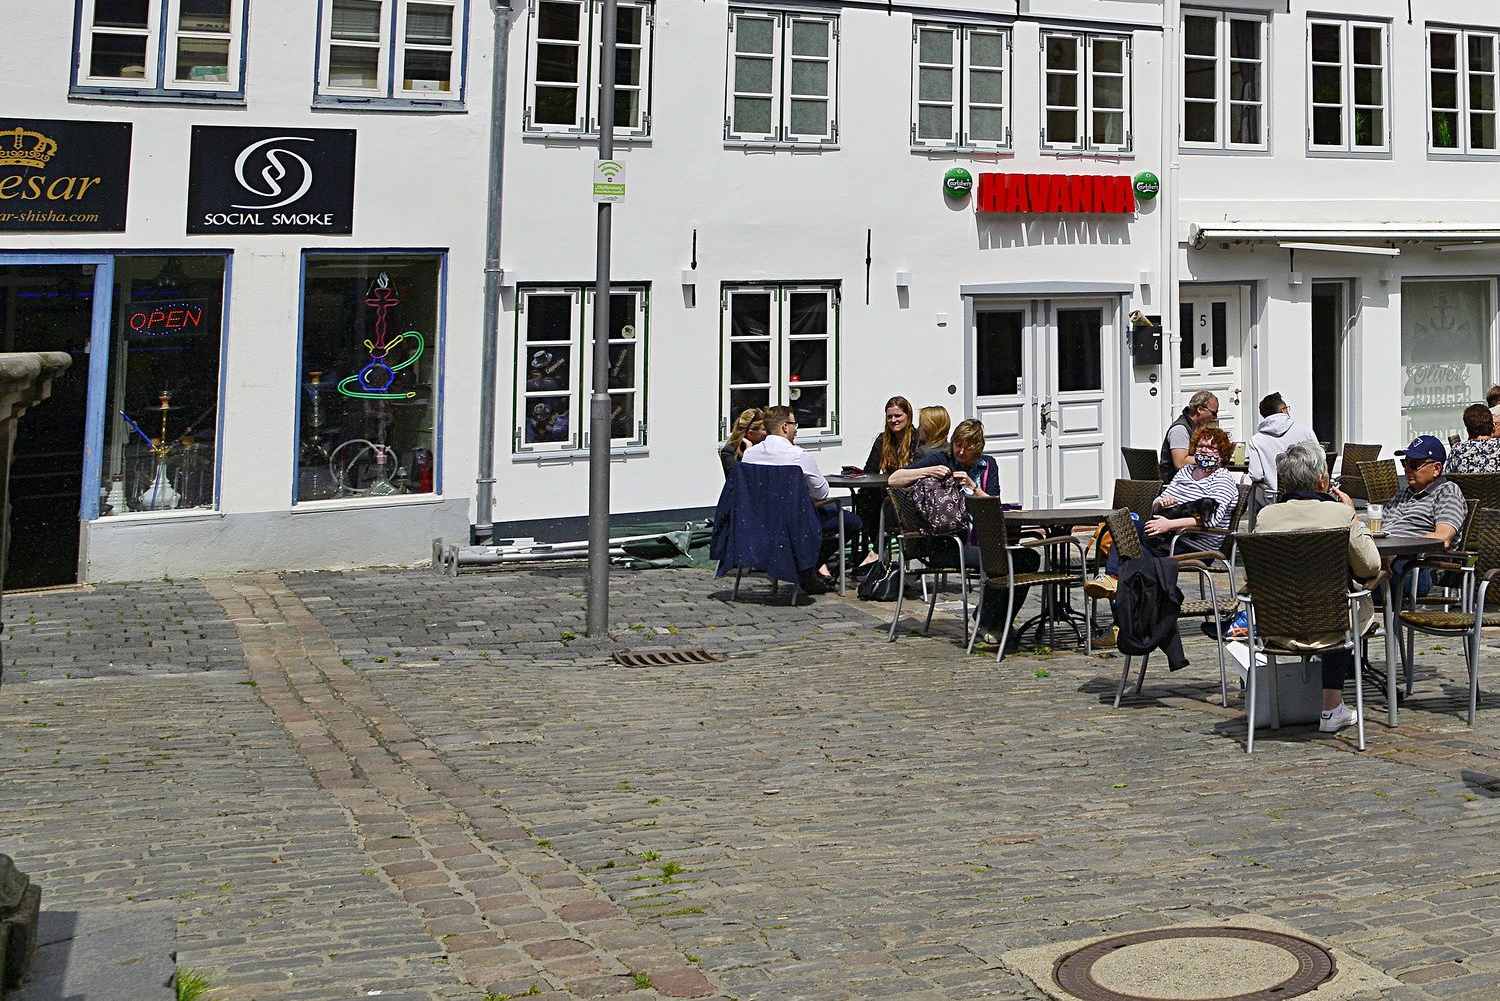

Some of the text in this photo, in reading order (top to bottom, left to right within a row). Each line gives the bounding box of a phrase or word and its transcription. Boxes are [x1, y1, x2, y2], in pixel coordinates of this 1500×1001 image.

[977, 172, 1136, 214] HAVANNA
[204, 213, 334, 226] SOCIAL SMOKE
[130, 310, 203, 330] OPEN
[1200, 315, 1207, 327] 5
[1153, 340, 1159, 351] 6
[1412, 384, 1472, 407] BURGER
